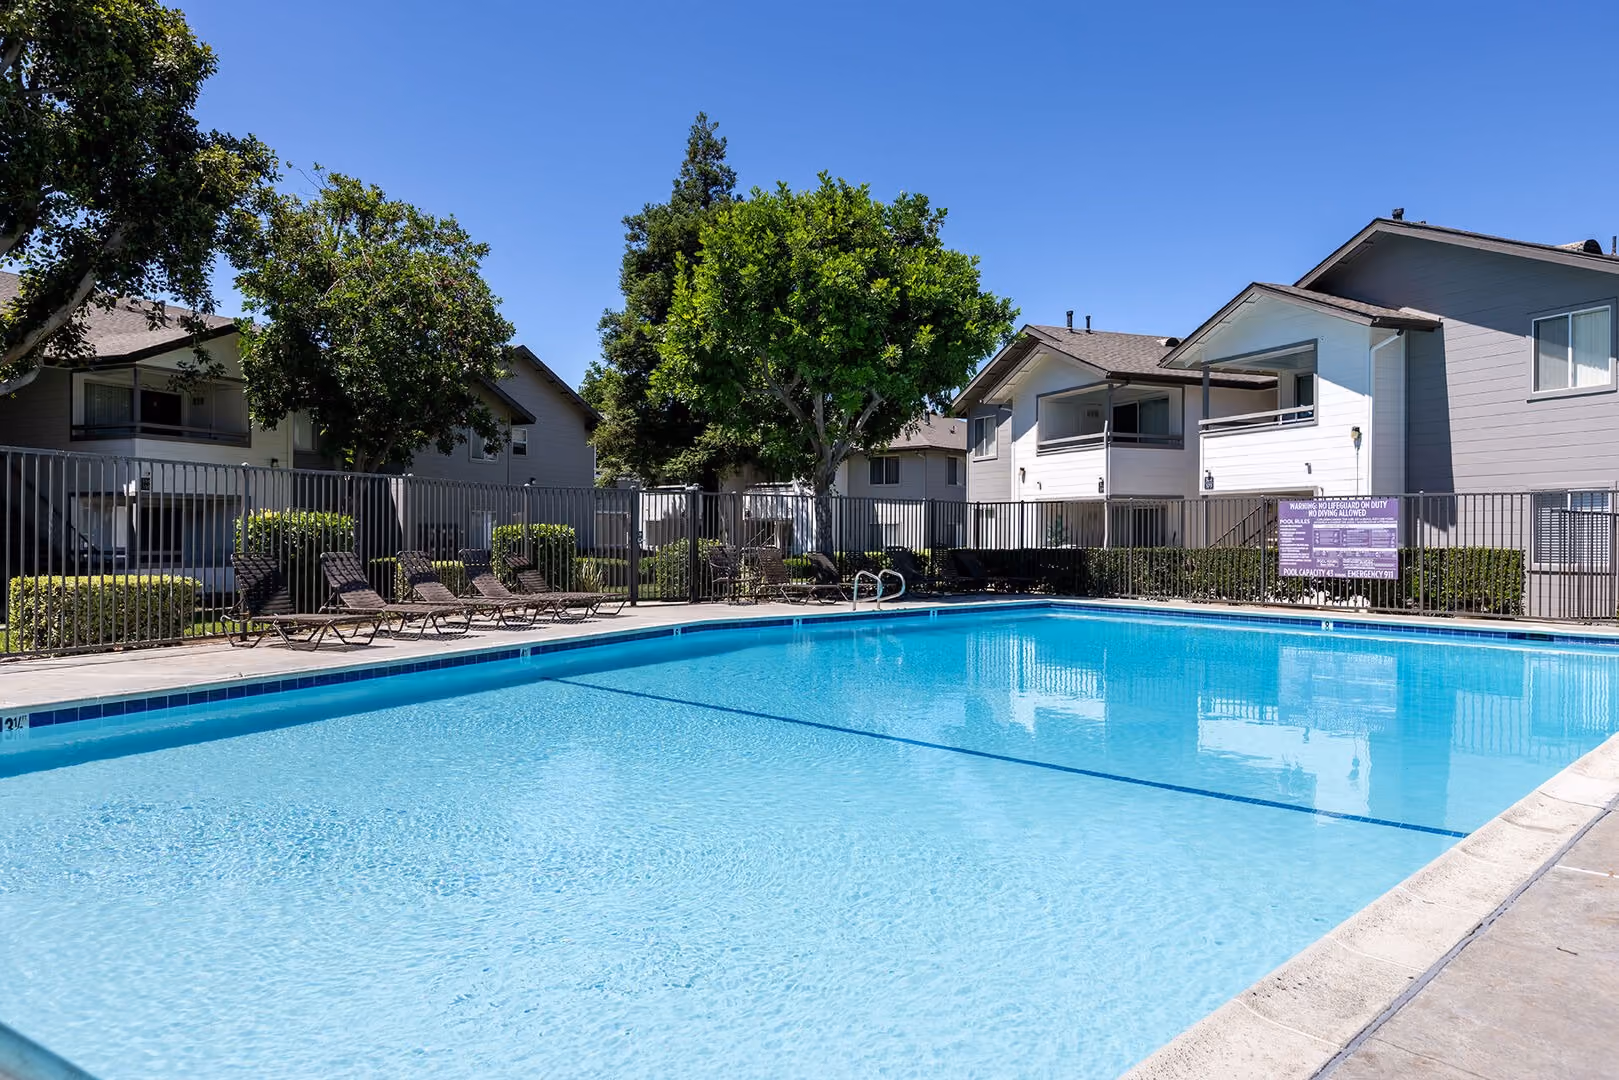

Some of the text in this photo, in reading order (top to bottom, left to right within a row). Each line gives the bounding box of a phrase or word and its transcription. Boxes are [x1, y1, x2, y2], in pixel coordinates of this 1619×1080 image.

[1289, 502, 1318, 510] WARNING:
[1328, 502, 1360, 510] LIFEGUARD
[1360, 501, 1370, 509] ON
[1371, 500, 1388, 509] DUTY
[1284, 568, 1299, 576] POOL
[1300, 568, 1326, 577] CAPACITY
[1347, 570, 1383, 578] EMERGENCY
